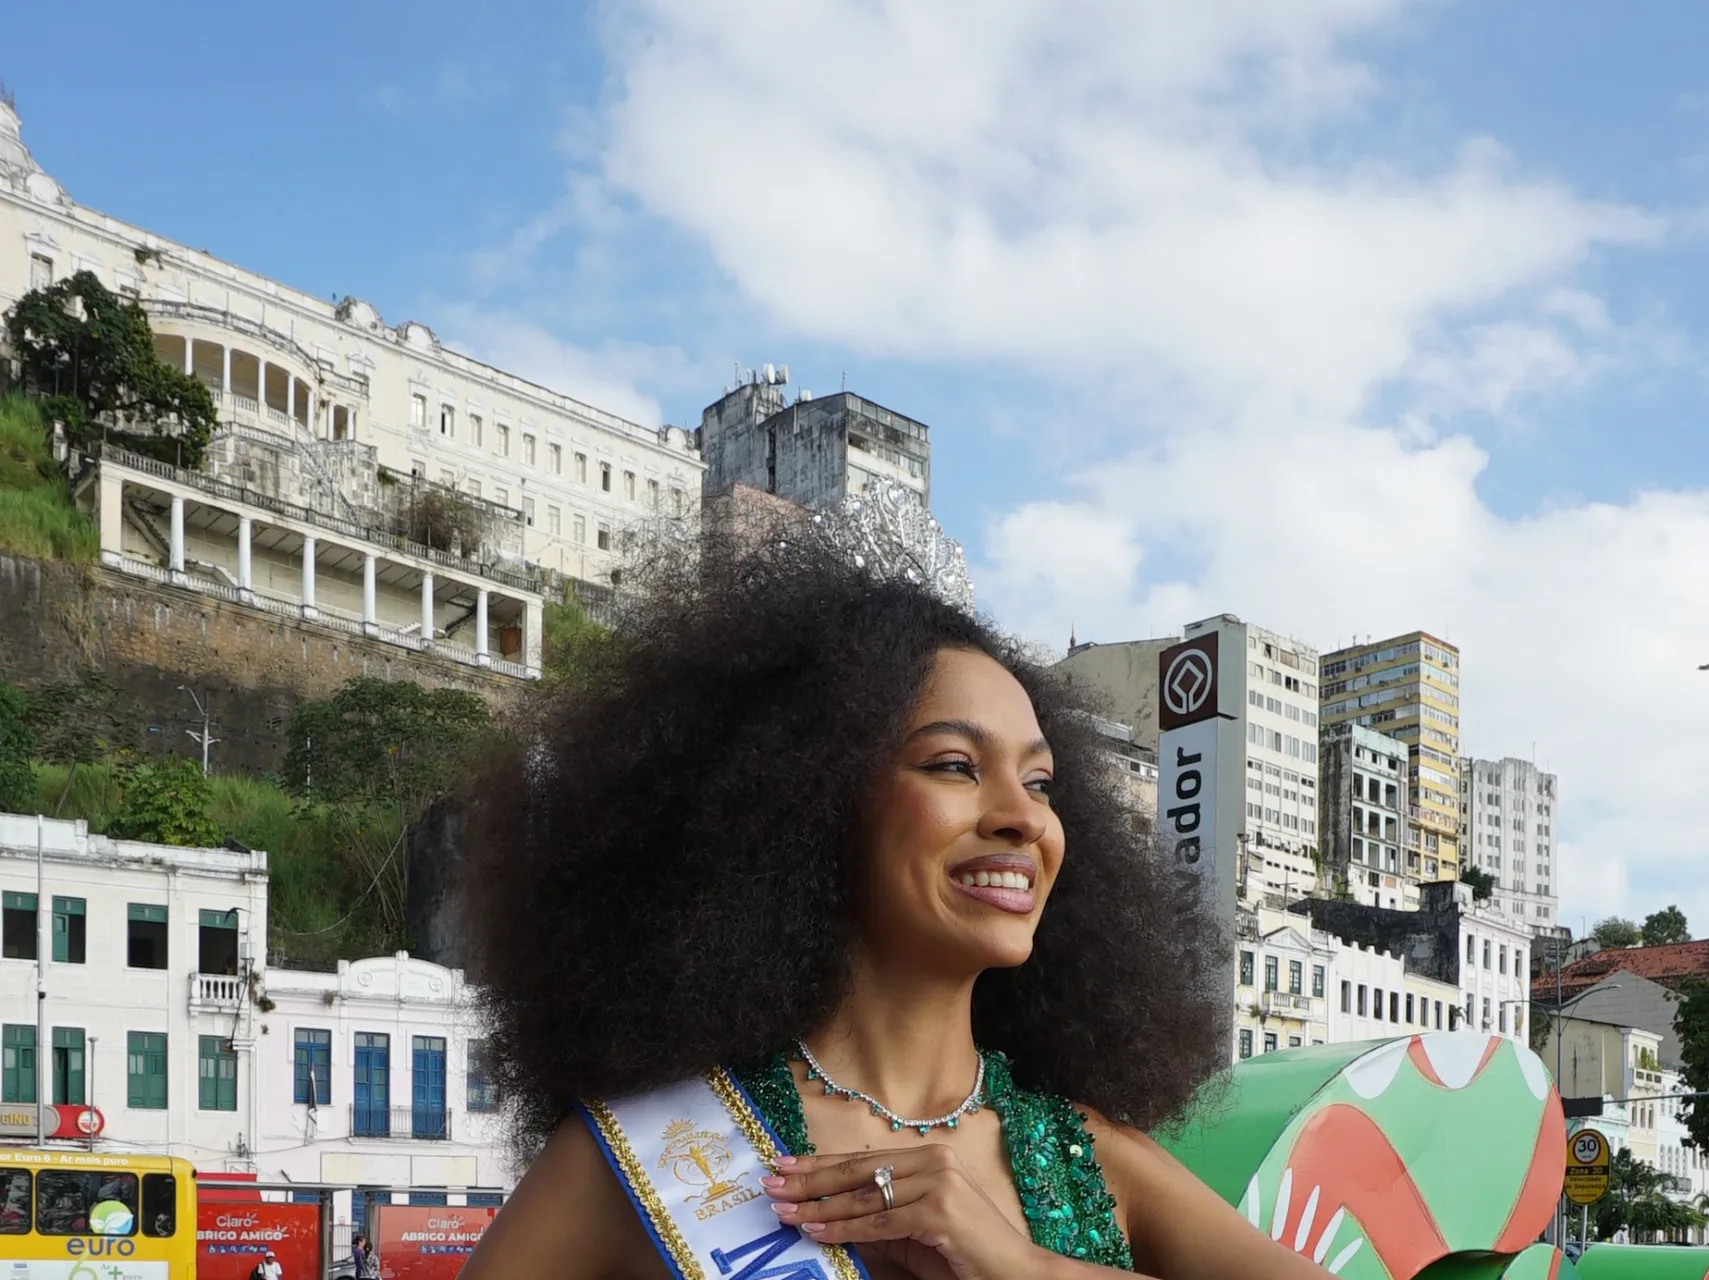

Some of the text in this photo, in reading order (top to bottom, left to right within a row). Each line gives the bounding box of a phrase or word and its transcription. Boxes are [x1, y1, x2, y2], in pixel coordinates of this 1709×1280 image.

[1, 1113, 32, 1126] GINO
[1578, 1139, 1597, 1153] 30
[15, 1153, 41, 1162] Euro
[60, 1155, 72, 1163] Ar
[75, 1156, 100, 1165] mais
[103, 1157, 128, 1166] puro
[1591, 1167, 1604, 1175] 30
[694, 1187, 762, 1221] BRASIL
[216, 1212, 256, 1228] Claro
[427, 1217, 461, 1229] Claro
[197, 1229, 284, 1241] BRIGO AMIGO
[401, 1232, 482, 1241] ABRIGO AMIG
[66, 1237, 135, 1257] euro
[122, 1273, 143, 1280] puro
